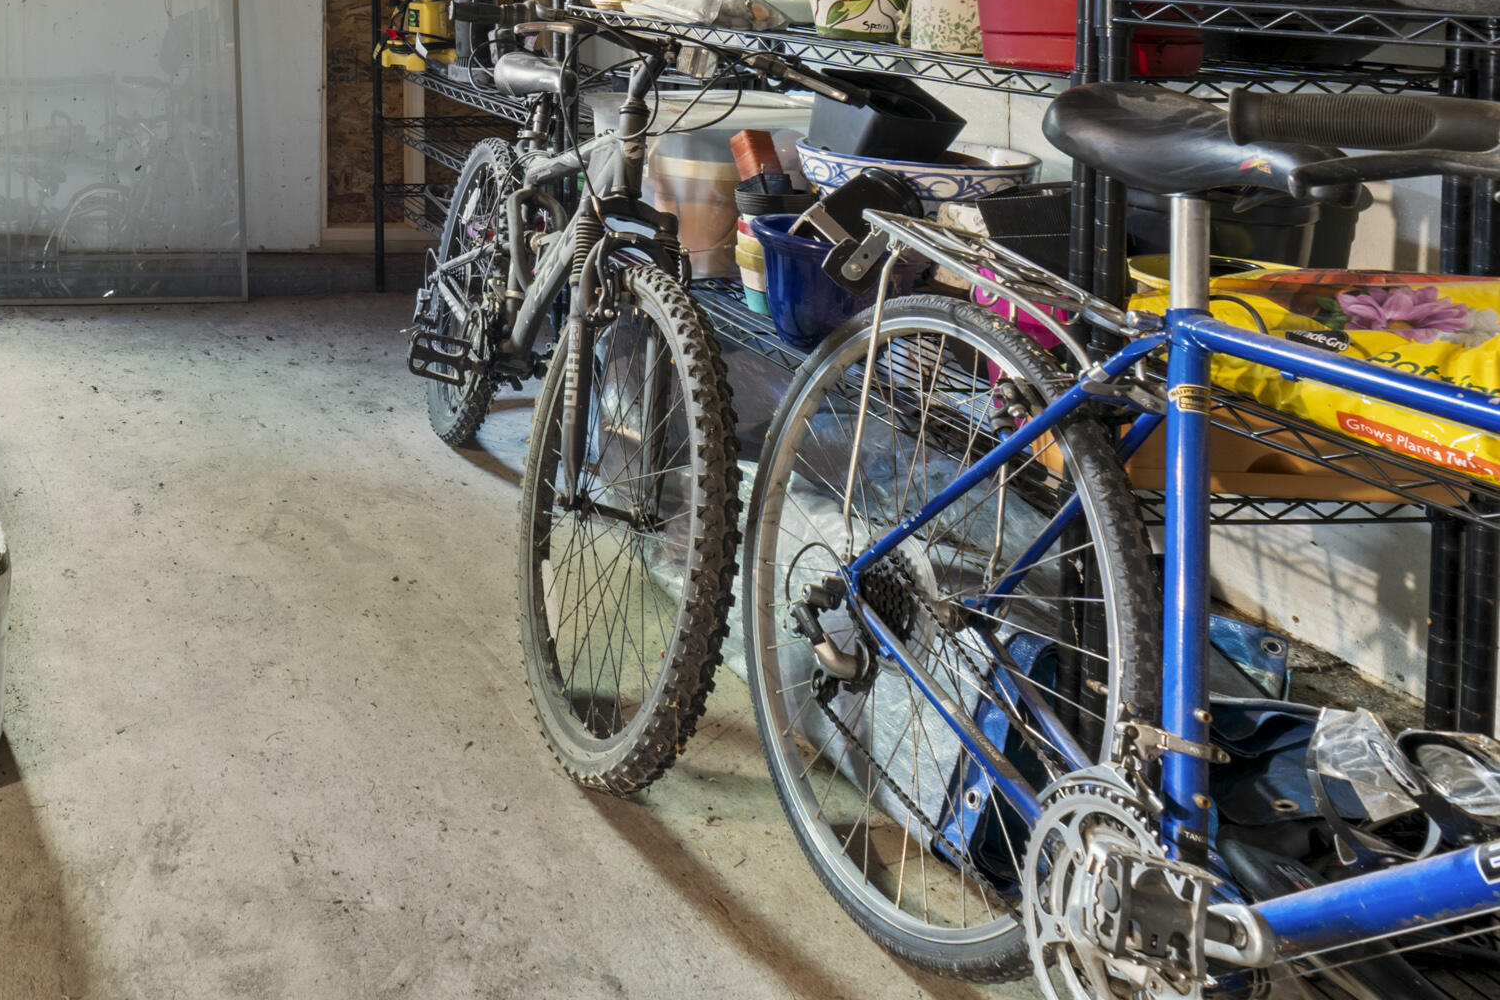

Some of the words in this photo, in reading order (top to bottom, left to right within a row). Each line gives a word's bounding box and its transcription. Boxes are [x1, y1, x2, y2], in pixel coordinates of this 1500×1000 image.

[1346, 418, 1393, 442] Grows
[1396, 434, 1442, 462] Plants
[1446, 450, 1494, 475] Twi
